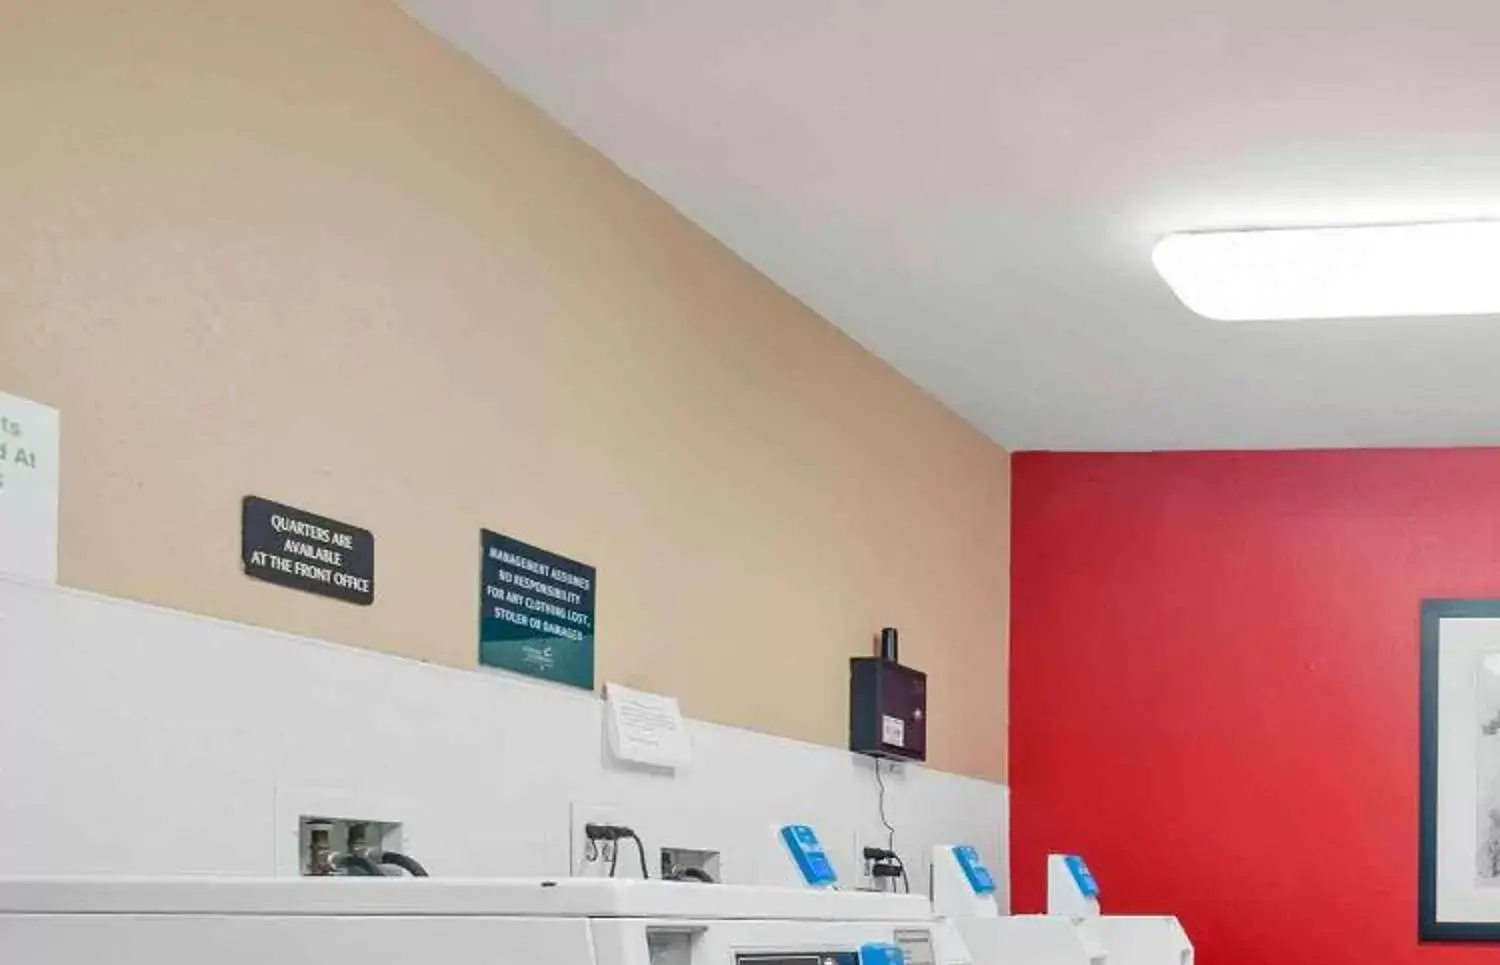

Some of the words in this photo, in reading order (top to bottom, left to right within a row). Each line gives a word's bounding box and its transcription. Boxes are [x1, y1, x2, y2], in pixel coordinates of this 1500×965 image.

[271, 514, 330, 543] QUARTERS
[331, 533, 353, 550] ARE
[283, 539, 342, 567] AVAILABLE
[489, 546, 550, 576] MANAGEMENT
[551, 568, 590, 591] ASSUMES
[251, 550, 267, 566] AT
[269, 554, 293, 573] THE
[294, 560, 332, 584] FRONT
[333, 571, 369, 593] OFFICE
[499, 569, 513, 583] NO
[486, 585, 505, 600] FOR
[506, 591, 525, 607] ANY
[525, 597, 567, 619] CLOTHING
[529, 617, 541, 630] OR
